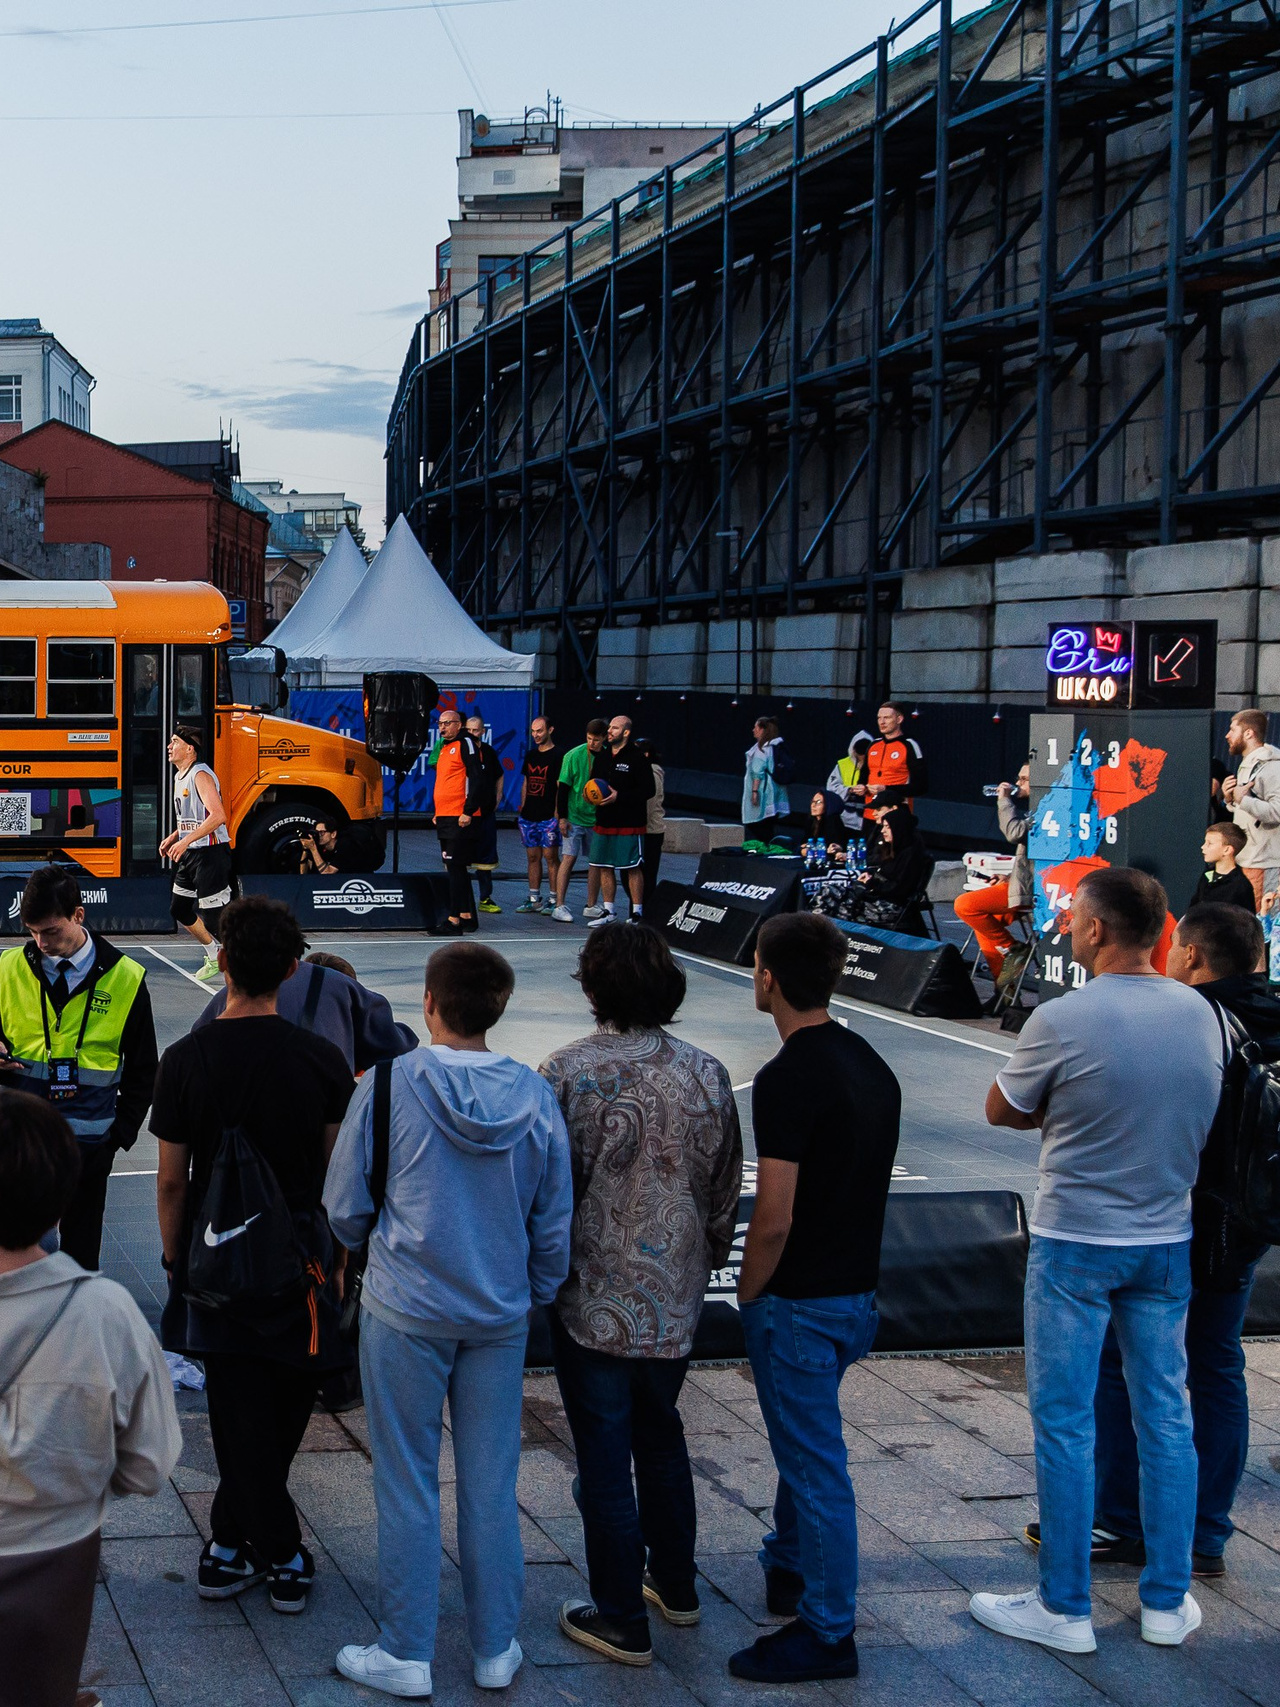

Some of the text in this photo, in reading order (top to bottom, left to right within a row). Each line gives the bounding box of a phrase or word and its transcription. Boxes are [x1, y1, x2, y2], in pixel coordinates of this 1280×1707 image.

[1056, 675, 1118, 701] ШКАФ
[1046, 738, 1121, 768] 1 2 3
[1041, 810, 1118, 844] 4 5 6
[313, 894, 404, 904] STREETBASKET
[1046, 884, 1060, 910] 7
[847, 938, 884, 954] епартамент
[90, 1005, 109, 1015] AFETY
